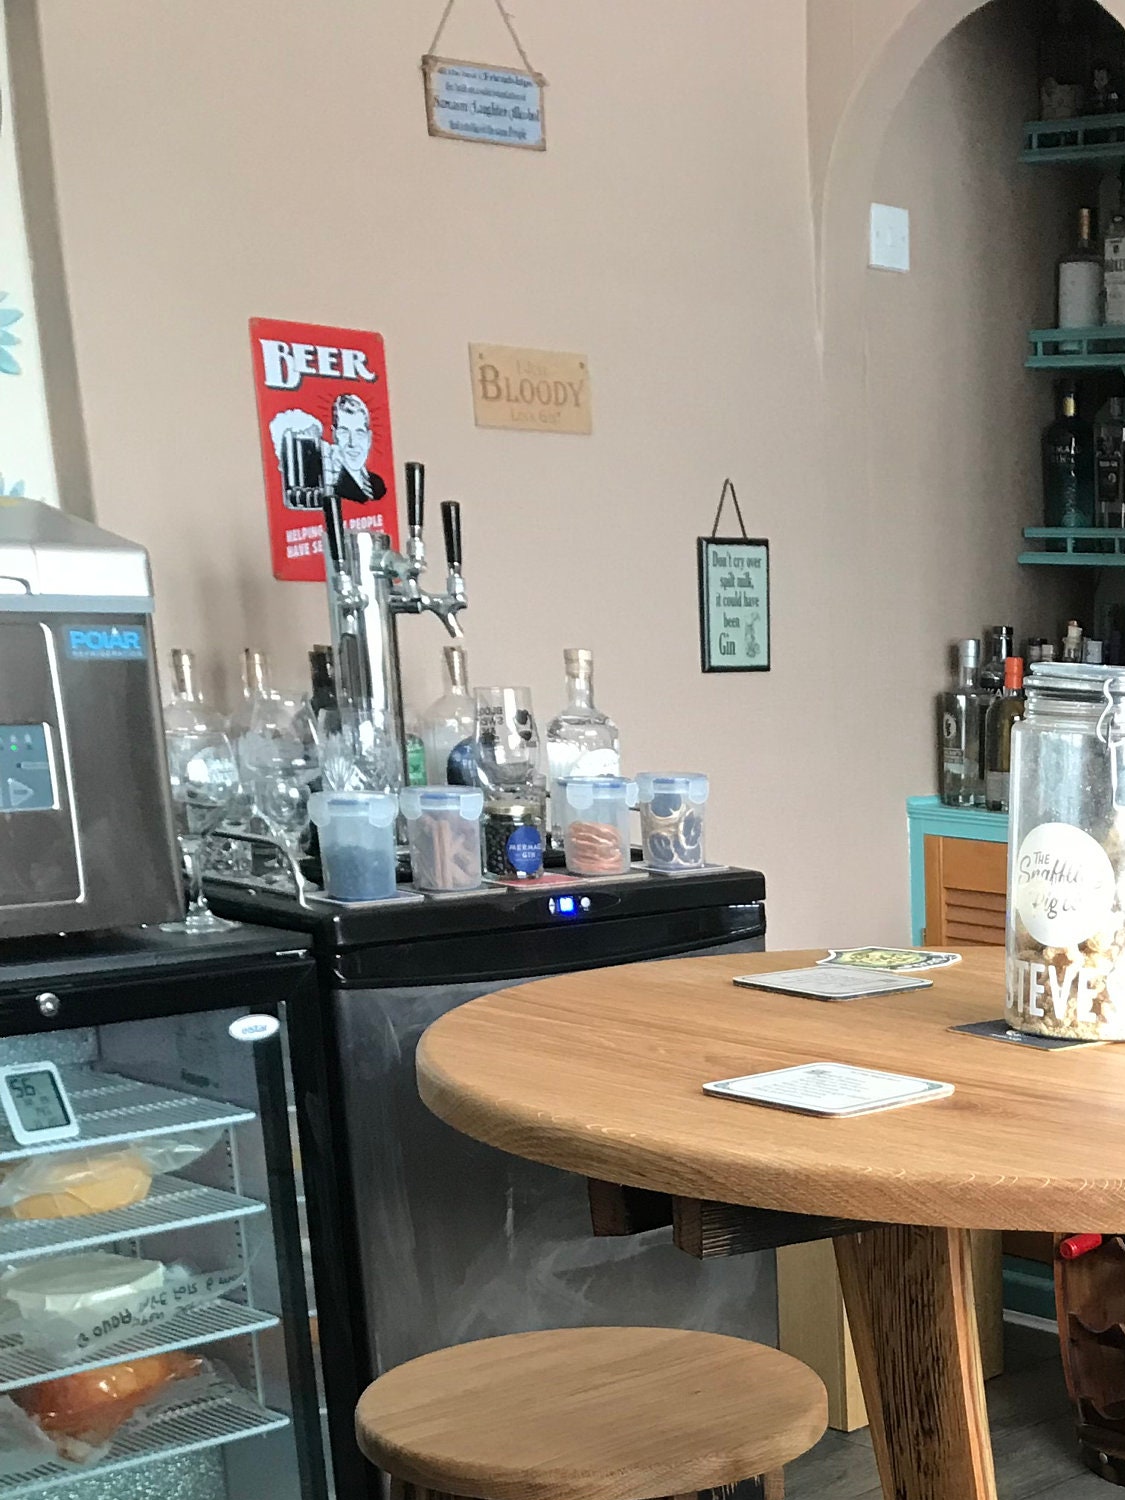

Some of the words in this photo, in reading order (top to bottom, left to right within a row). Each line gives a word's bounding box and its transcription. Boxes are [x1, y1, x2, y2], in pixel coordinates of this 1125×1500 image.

[258, 338, 378, 391] BEER
[478, 364, 584, 407] BLOODY
[349, 514, 384, 530] PEOPLE
[286, 543, 310, 559] HAVE
[312, 541, 324, 554] SE
[712, 550, 732, 568] Don't
[733, 557, 745, 570] cry
[747, 557, 762, 569] over
[715, 592, 721, 607] it
[723, 591, 742, 607] could
[743, 591, 759, 607] have
[723, 612, 740, 628] been
[69, 627, 141, 650] POLAR
[719, 632, 736, 656] Gin
[1034, 851, 1050, 865] THE
[1006, 958, 1100, 1024] STEVE
